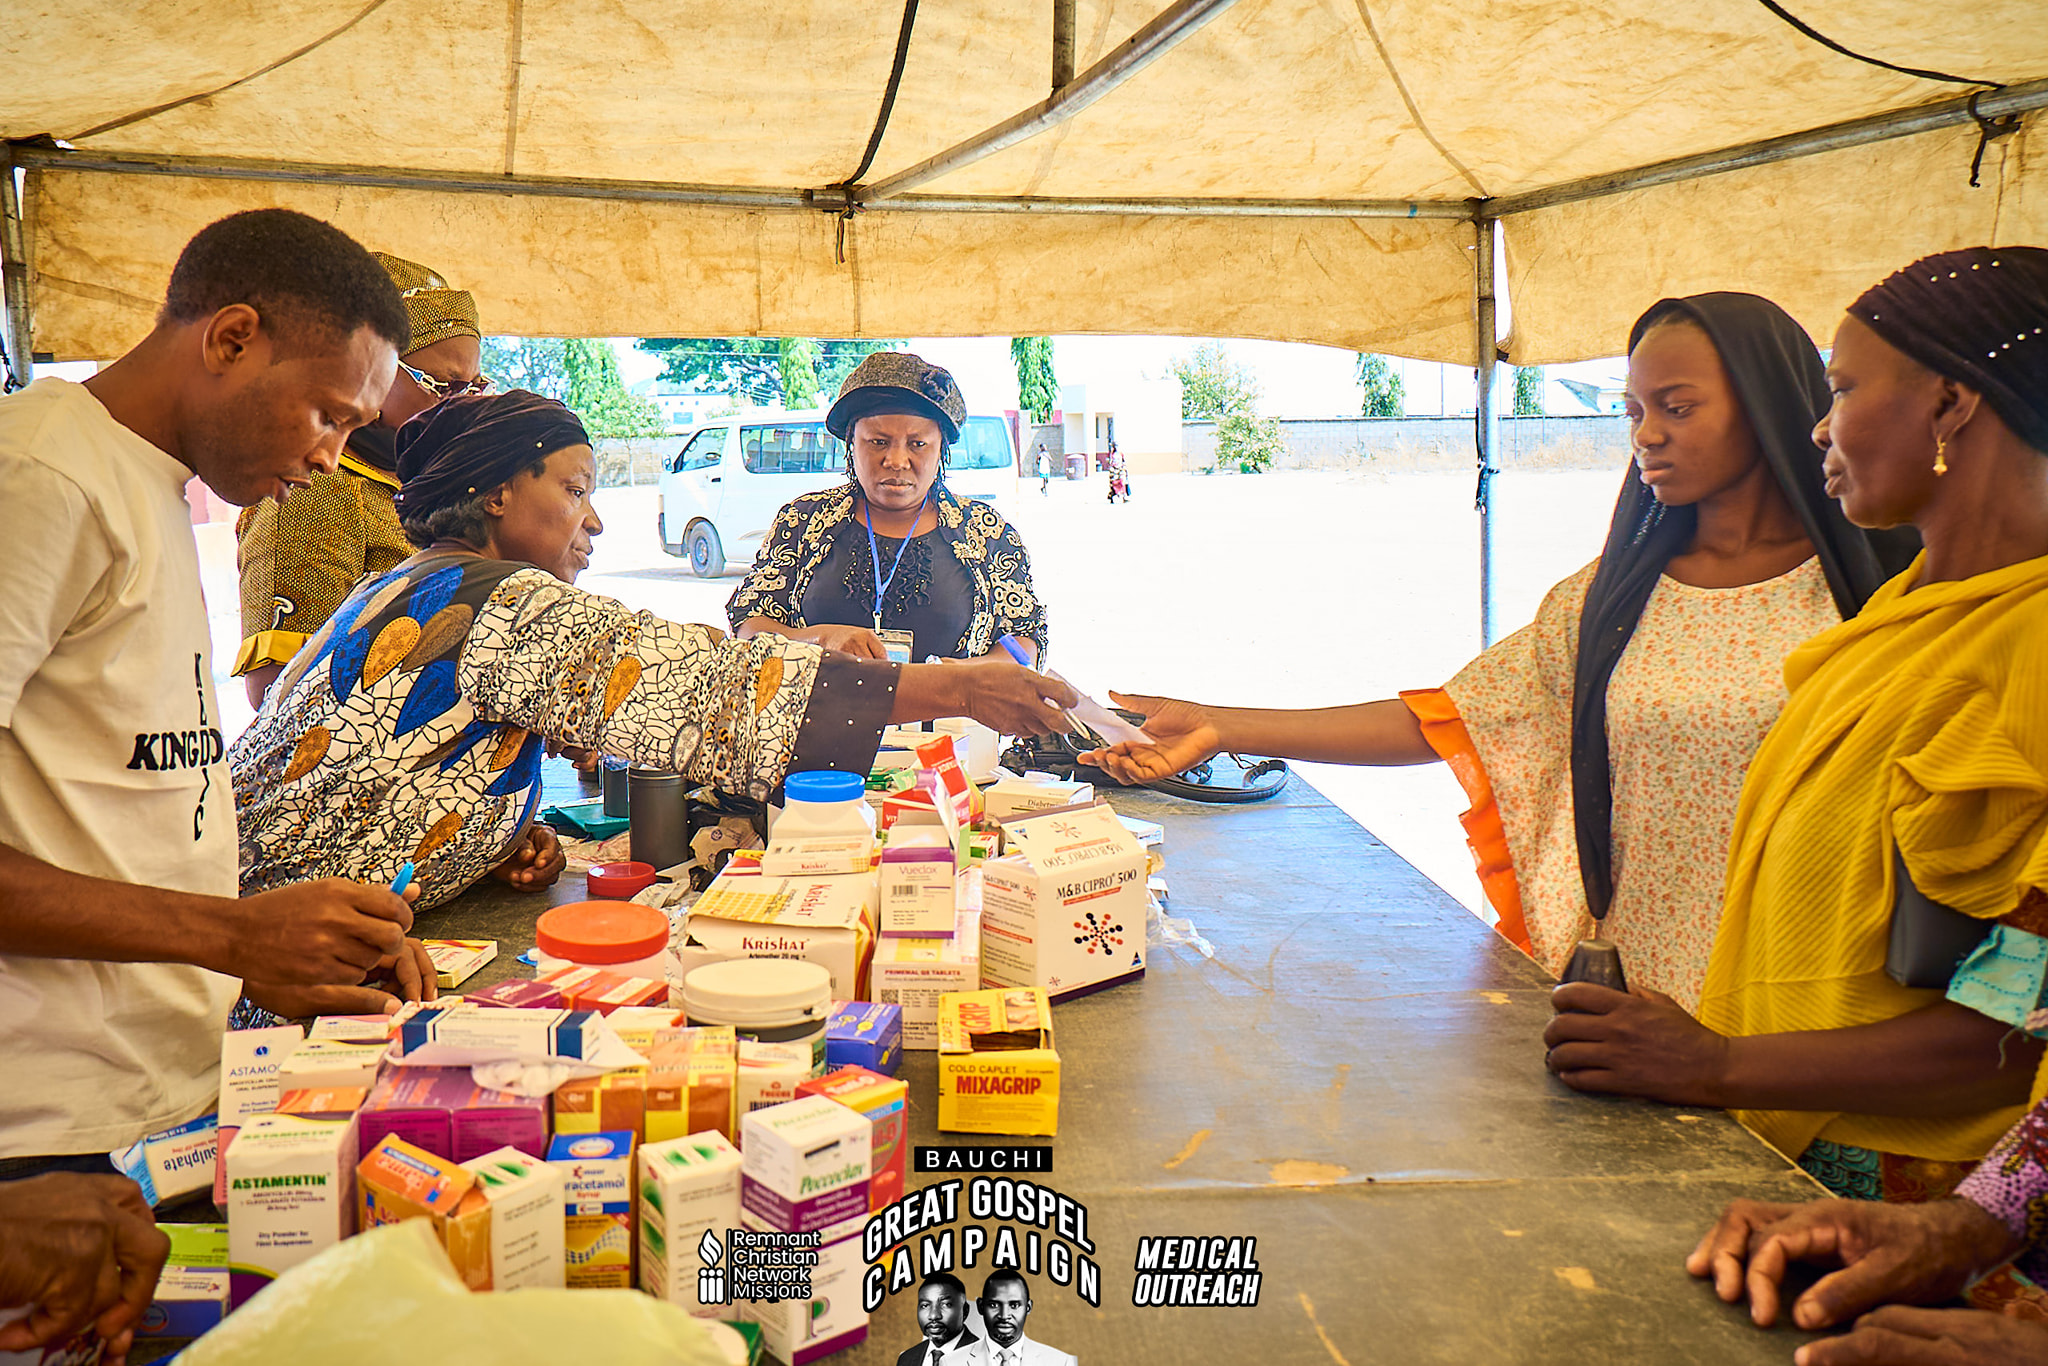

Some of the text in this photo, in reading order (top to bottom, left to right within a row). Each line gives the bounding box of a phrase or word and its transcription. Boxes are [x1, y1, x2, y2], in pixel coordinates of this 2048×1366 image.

[1043, 855, 1066, 868] 500
[1056, 869, 1137, 901] M&B CIPRO 500
[948, 1064, 977, 1073] COLD
[979, 1065, 1017, 1075] CAPLET
[956, 1075, 1042, 1095] MIXAGRIP
[232, 1174, 327, 1190] ASTAMENTIN
[564, 1176, 626, 1191] racetamol
